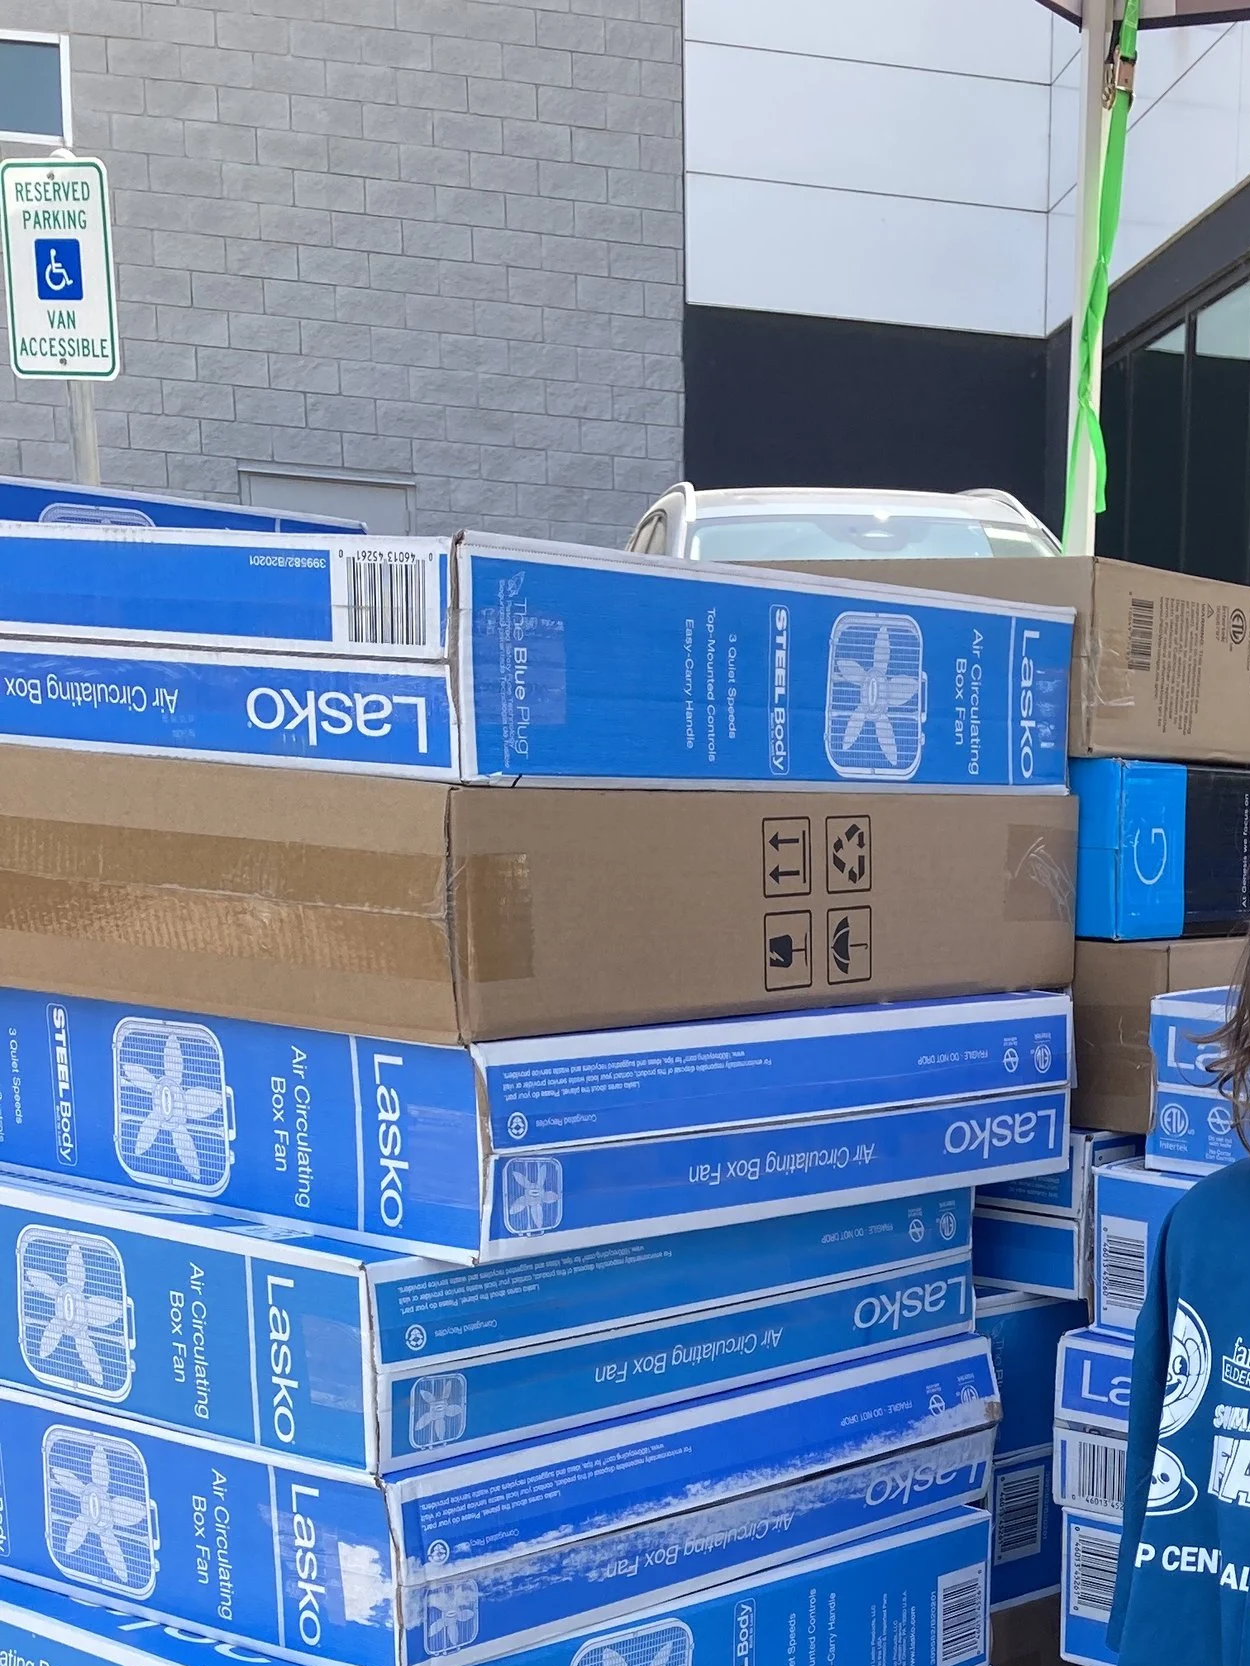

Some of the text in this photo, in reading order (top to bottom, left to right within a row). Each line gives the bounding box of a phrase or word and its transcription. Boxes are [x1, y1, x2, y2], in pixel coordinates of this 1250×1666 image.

[15, 182, 90, 202] RESERVED
[23, 210, 87, 230] PARKING
[20, 337, 109, 358] ACCESSIBLE
[47, 310, 76, 329] VAN
[249, 554, 327, 569] 399582/B20201
[356, 549, 417, 563] 46013 45261
[5, 673, 178, 714] Air Circulating Box
[513, 598, 530, 759] The Blue Plug
[684, 619, 695, 749] Easy-Carry Handle
[706, 608, 716, 762] Top-Mounted Controls
[727, 634, 737, 740] 3 Quiet Speeds
[772, 609, 788, 770] STEEL Body
[955, 658, 967, 745] Box Fan
[968, 629, 983, 775] Air Circulating
[1020, 629, 1040, 779] Lasko
[247, 687, 428, 754] Lasko
[1133, 828, 1167, 885] G
[8, 1028, 23, 1124] 3 Quiet Speeds
[53, 1008, 72, 1163] STEEL Body
[918, 1050, 988, 1065] FRAGILE DO NOT DROP
[271, 1077, 289, 1172] Box Fan
[291, 1046, 311, 1208] Air Circulating
[374, 1054, 408, 1227] Lasko
[535, 1113, 597, 1127] Corrugated Recycles
[944, 1108, 1056, 1159] Lasko
[1159, 1140, 1188, 1152] Intertek
[689, 1143, 875, 1186] Air Circulating Box Fan
[169, 1289, 186, 1383] Box Fan
[190, 1263, 209, 1420] Air Circulating
[854, 1276, 966, 1331] Lasko
[266, 1274, 296, 1446] Lasko
[291, 1482, 322, 1648] Lasko
[737, 1603, 753, 1648] Body
[809, 1588, 817, 1632] Controls
